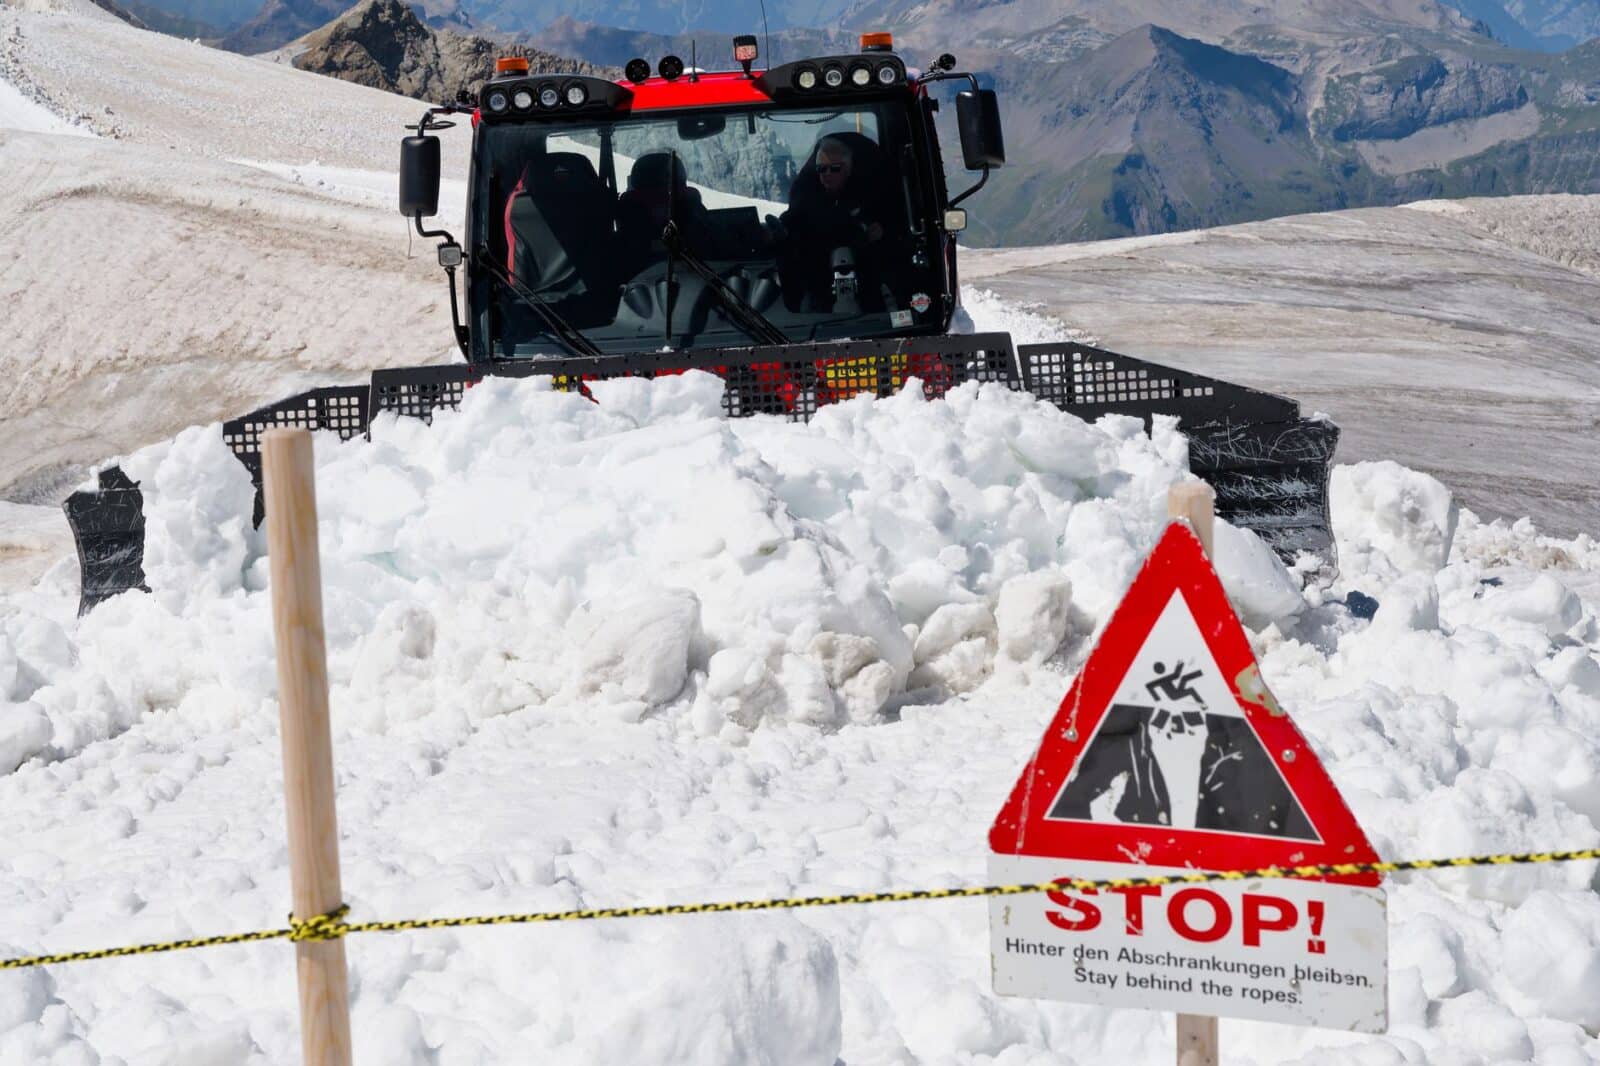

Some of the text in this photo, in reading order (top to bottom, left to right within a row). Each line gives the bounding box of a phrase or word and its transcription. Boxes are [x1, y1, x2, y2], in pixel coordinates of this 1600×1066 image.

[1045, 876, 1326, 954] STOP!
[1005, 937, 1374, 988] Hinter den Abschrankungen bleiben.
[1074, 967, 1303, 1005] Stay behind the ropes.
